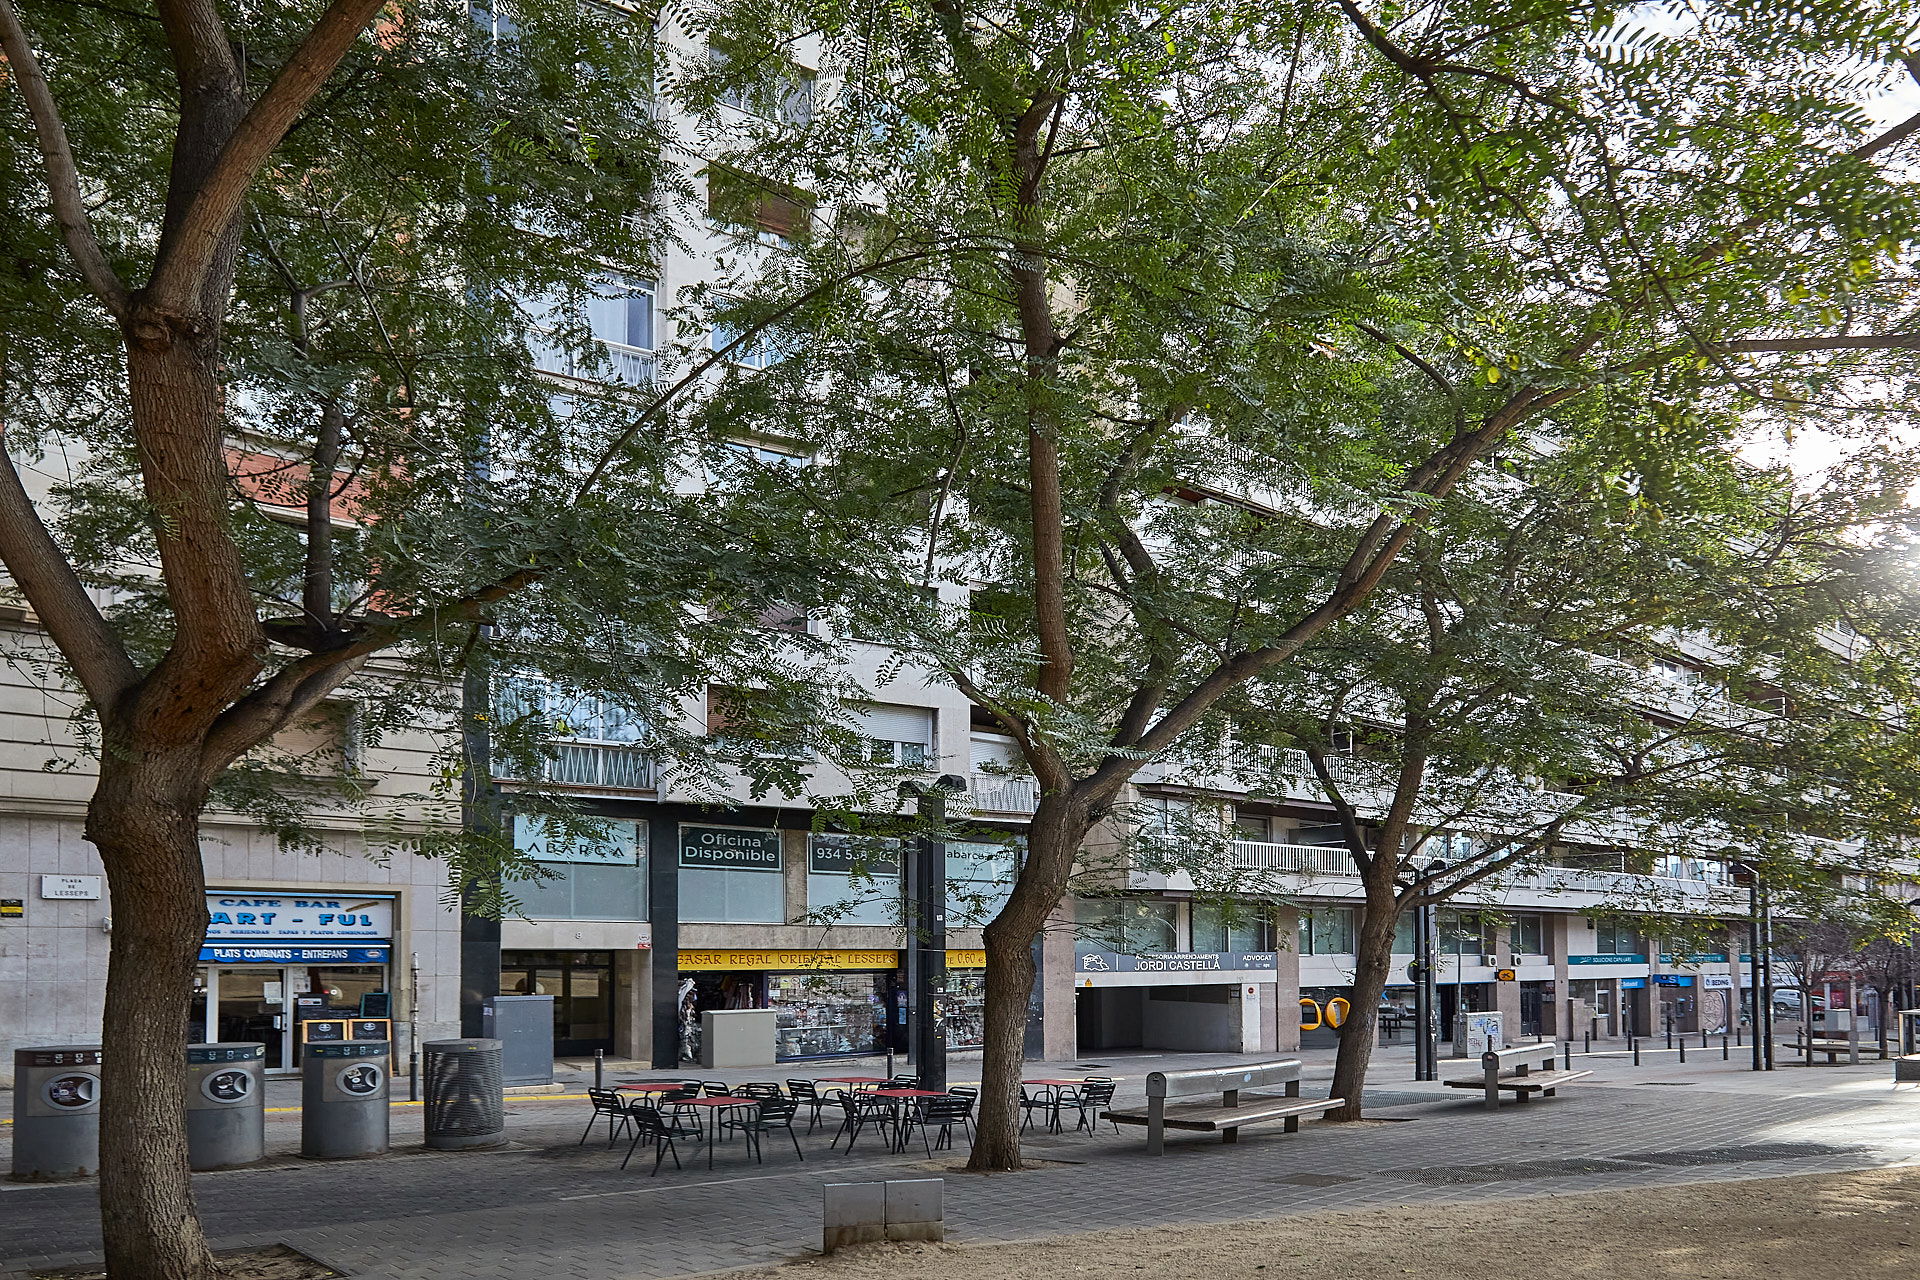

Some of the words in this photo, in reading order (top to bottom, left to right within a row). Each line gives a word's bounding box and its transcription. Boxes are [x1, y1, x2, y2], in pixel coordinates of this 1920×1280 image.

[701, 833, 761, 847] Oficina
[527, 842, 625, 858] ABARCA
[685, 846, 775, 861] Disponible
[816, 847, 841, 859] 934
[219, 899, 281, 908] CAFE
[294, 900, 341, 909] BAR
[319, 913, 373, 927] FUL
[214, 948, 241, 958] PLATS
[244, 949, 292, 959] COMBINATS
[302, 949, 348, 959] ENTREPANS
[730, 954, 772, 966] REGAL
[779, 954, 842, 964] ORIENTAL
[848, 953, 896, 964] LESSEPS
[1134, 961, 1166, 971] JORDI
